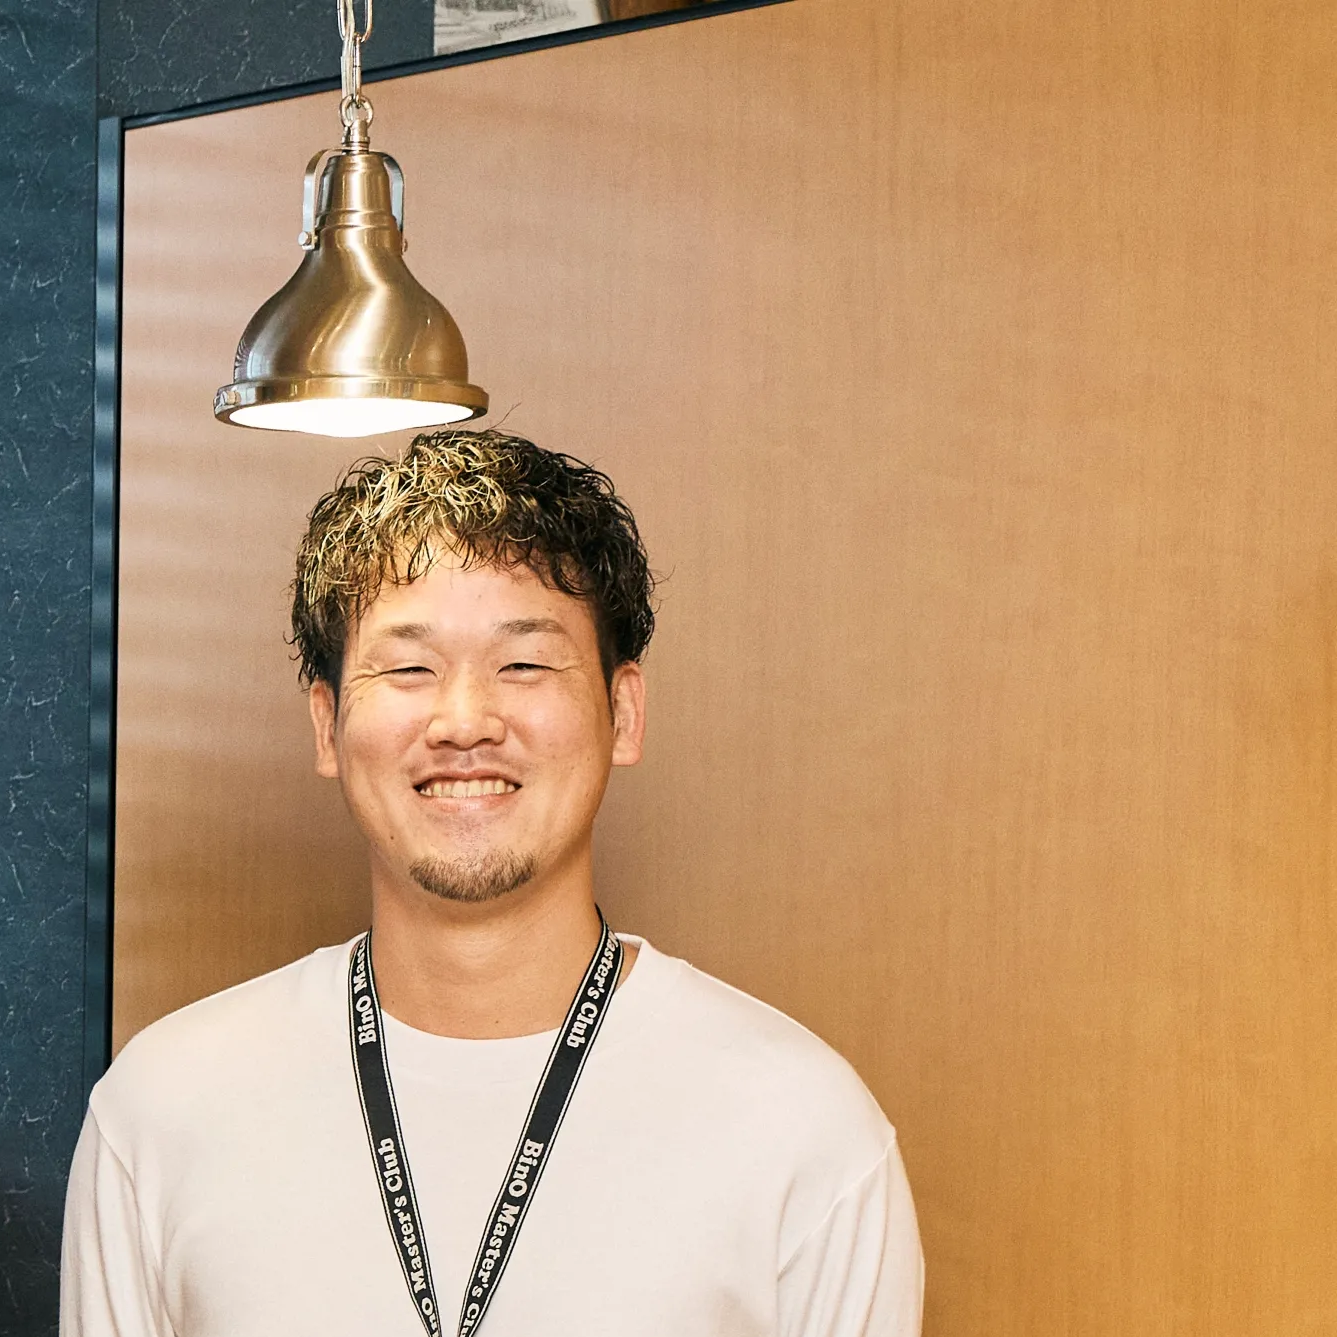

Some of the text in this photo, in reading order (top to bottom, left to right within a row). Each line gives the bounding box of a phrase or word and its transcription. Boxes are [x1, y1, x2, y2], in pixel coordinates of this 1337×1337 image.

[355, 995, 377, 1046] BinO
[566, 1001, 599, 1049] Club
[377, 1137, 403, 1193] Club
[508, 1138, 544, 1198] BinO
[393, 1195, 427, 1294] Master's
[471, 1202, 521, 1298] Master's
